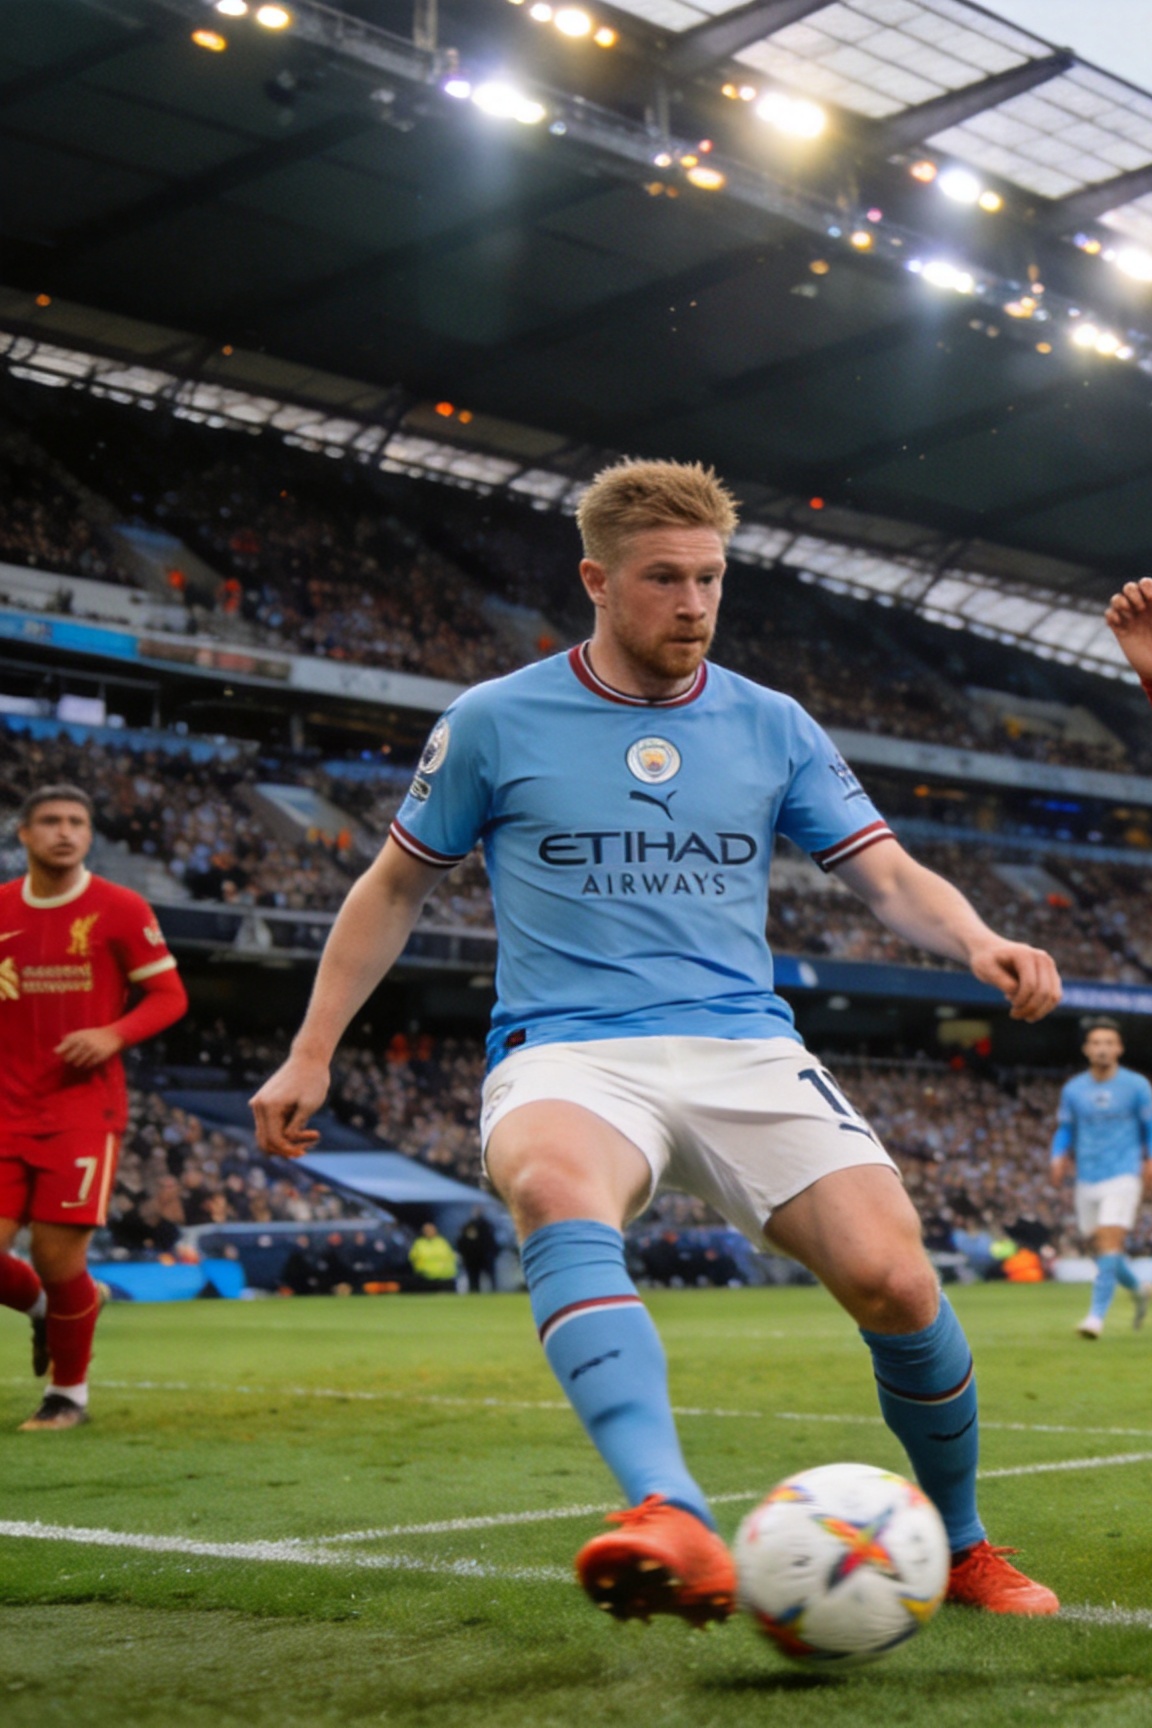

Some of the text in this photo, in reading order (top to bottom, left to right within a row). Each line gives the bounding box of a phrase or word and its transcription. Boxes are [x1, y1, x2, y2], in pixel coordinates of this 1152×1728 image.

[538, 831, 758, 865] ETIHAD
[581, 873, 727, 896] AIRWAYS
[75, 1156, 98, 1201] 7
